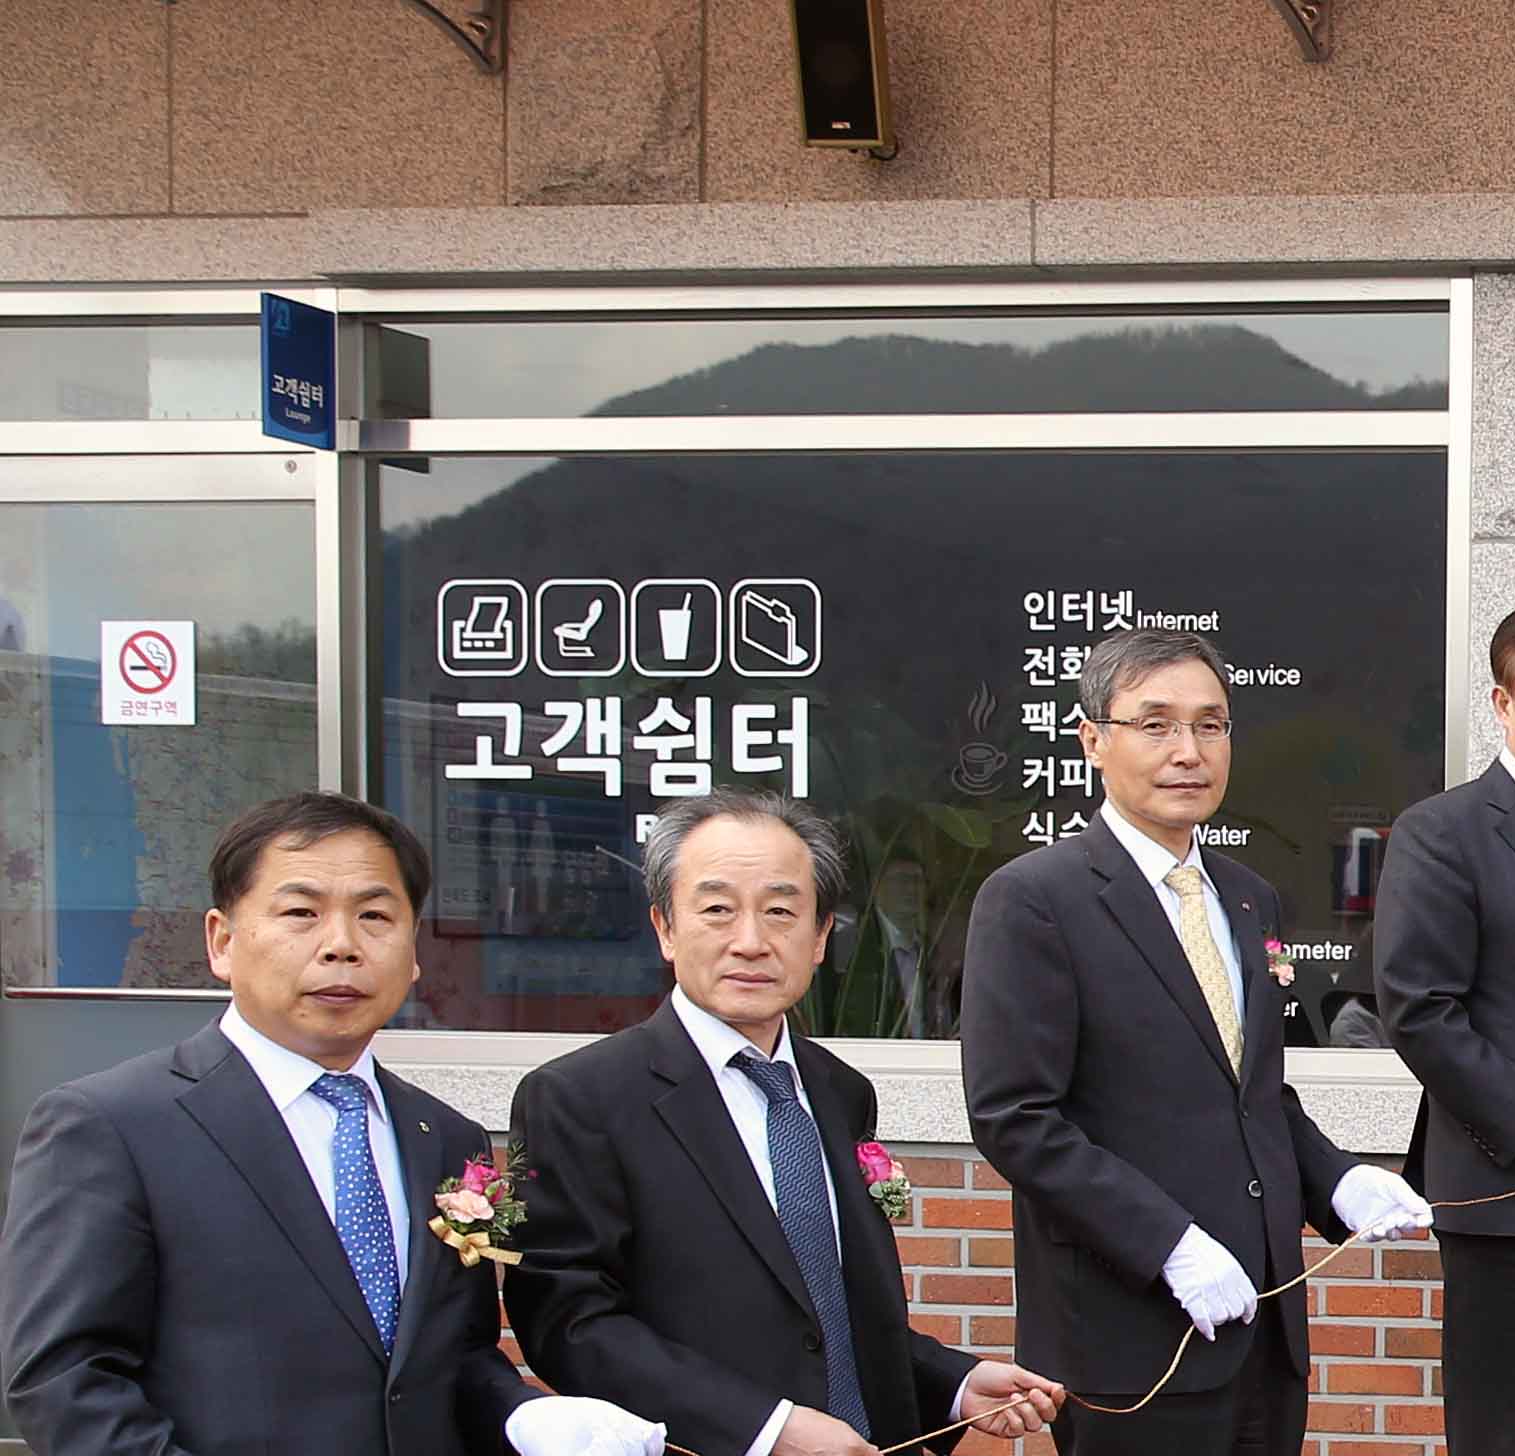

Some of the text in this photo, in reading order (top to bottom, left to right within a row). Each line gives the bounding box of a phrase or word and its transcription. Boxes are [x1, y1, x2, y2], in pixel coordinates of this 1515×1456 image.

[272, 374, 323, 408] 고객쉼터
[1023, 591, 1219, 631] 인터넷 Internet
[120, 701, 177, 716] 금연구역
[444, 696, 809, 798] 고객쉼터
[1022, 756, 1093, 797] 커피
